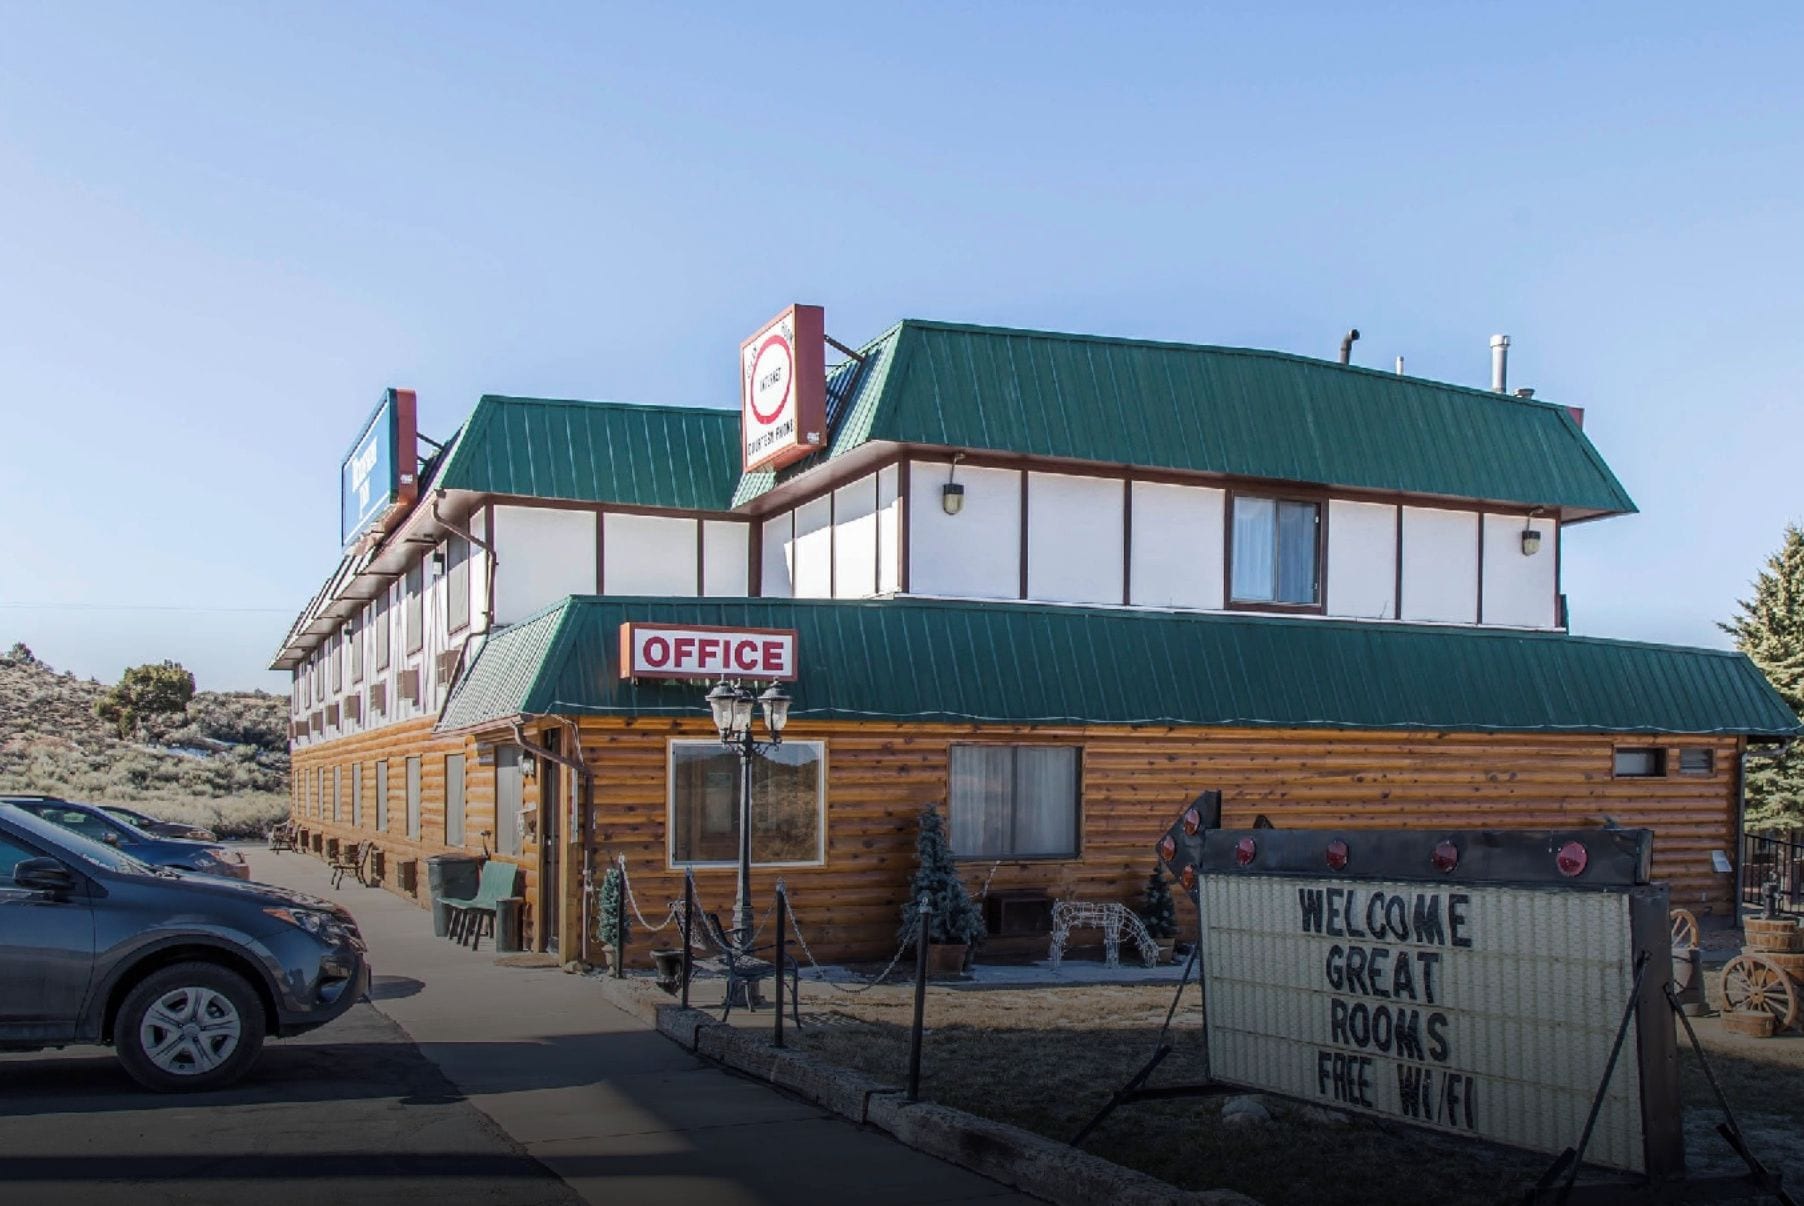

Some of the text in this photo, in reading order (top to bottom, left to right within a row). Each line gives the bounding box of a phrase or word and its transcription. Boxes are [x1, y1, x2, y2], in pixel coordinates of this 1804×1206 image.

[642, 636, 784, 671] OFFICE
[1298, 887, 1472, 948] WELCOME
[1326, 944, 1439, 1004] GREAT
[1331, 998, 1449, 1062] ROOMS
[1317, 1050, 1374, 1108] FREE
